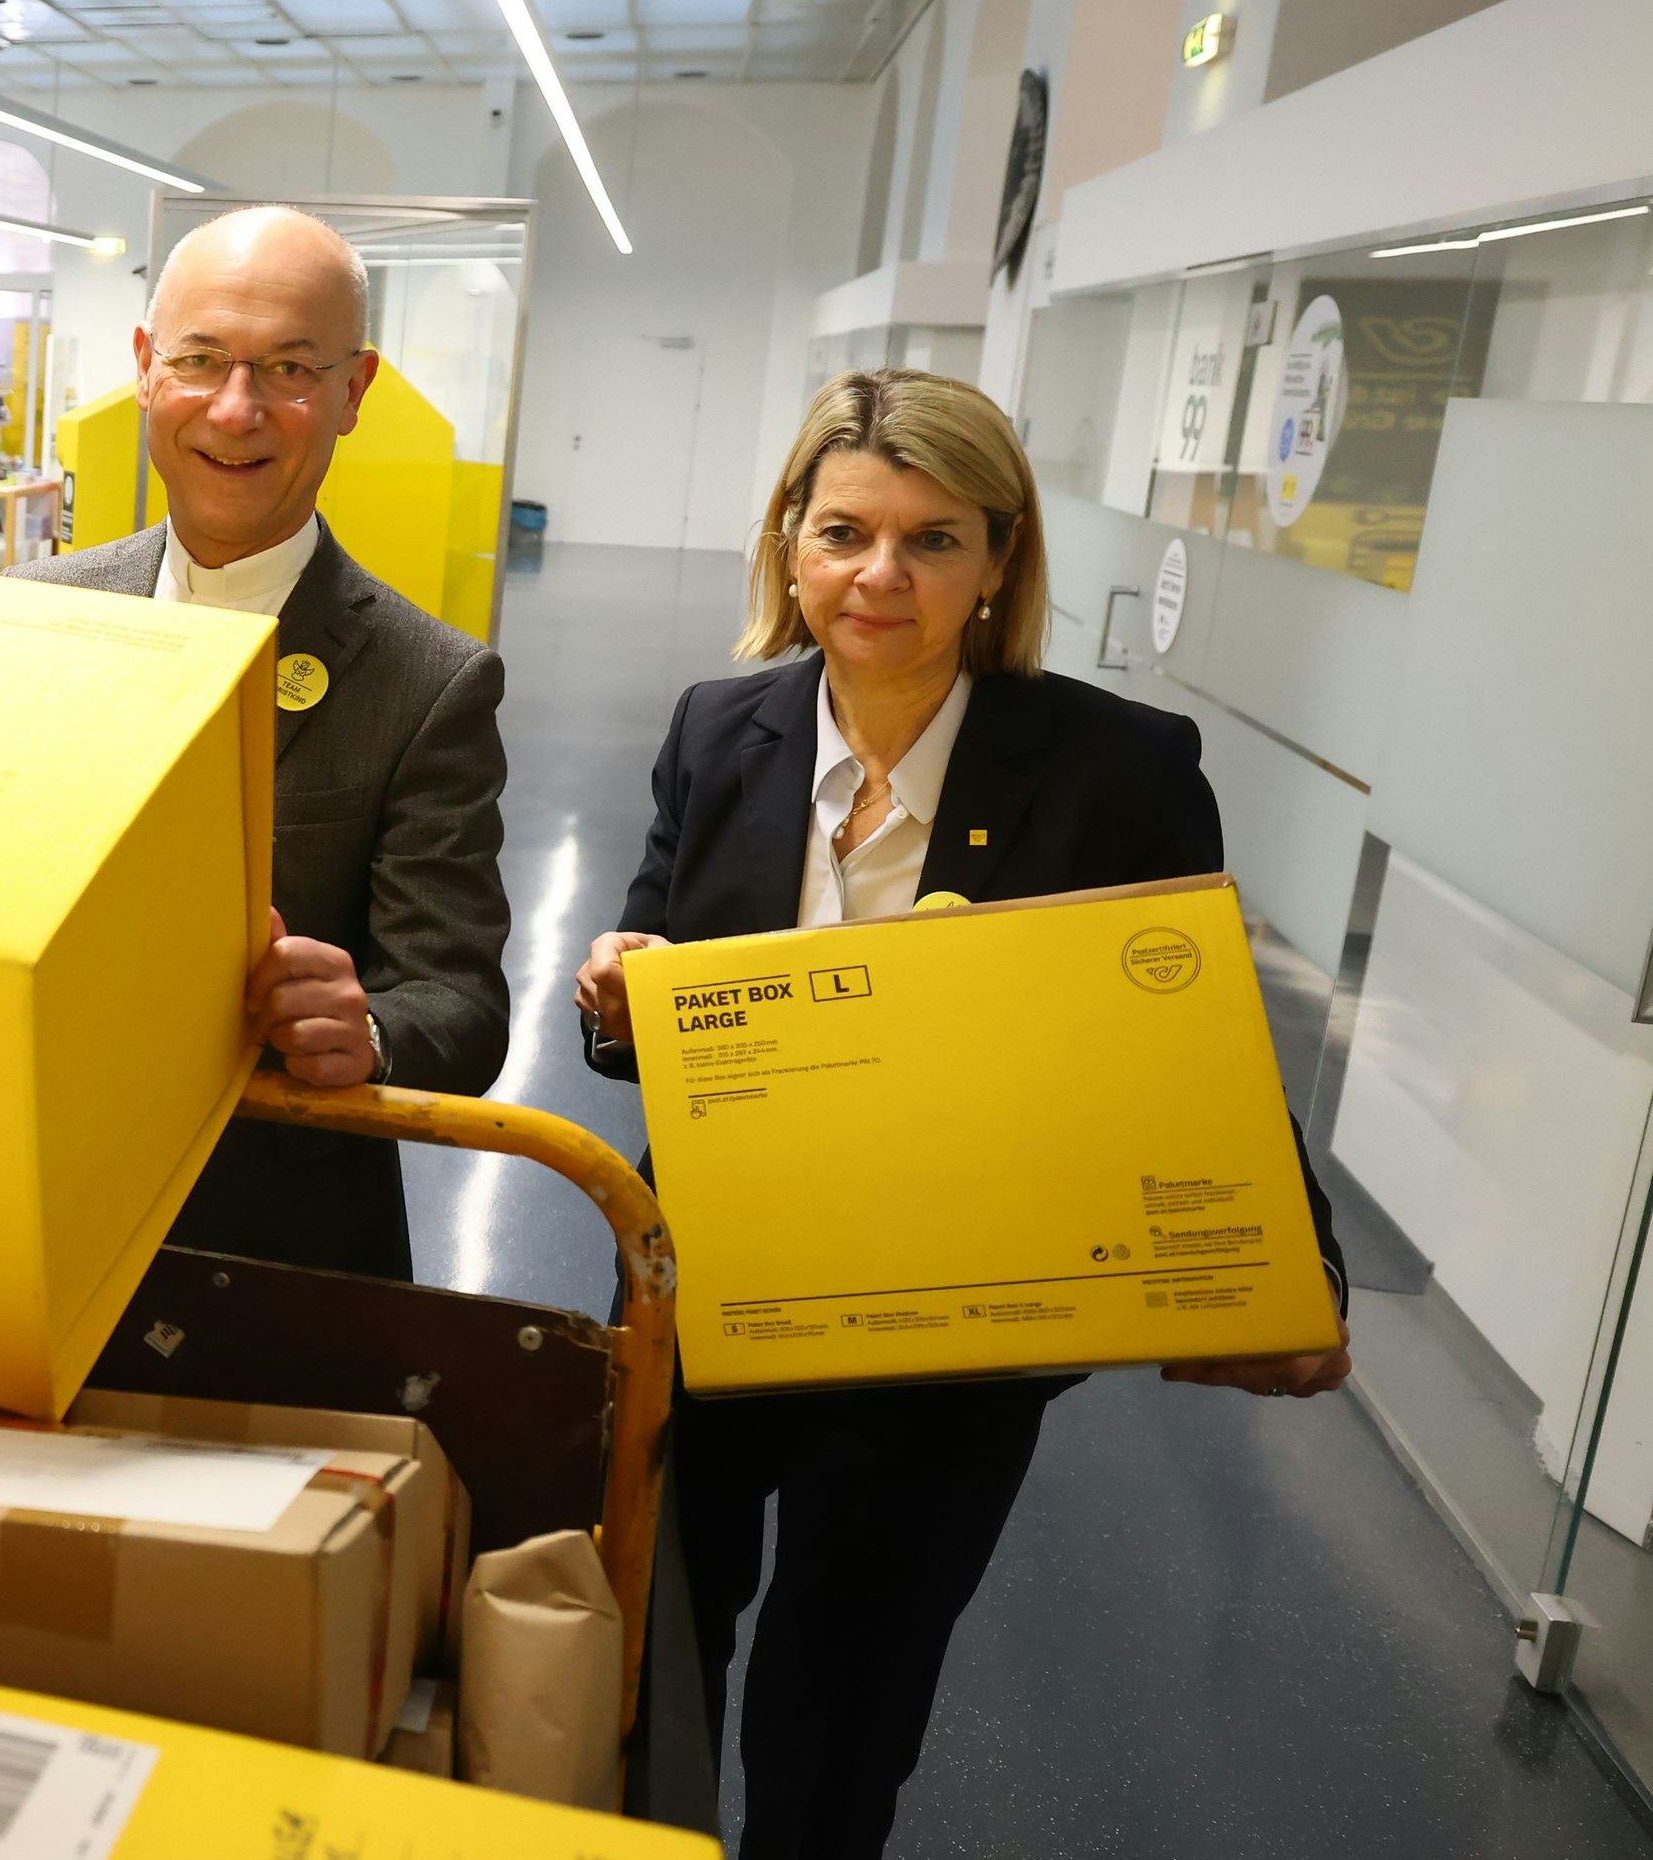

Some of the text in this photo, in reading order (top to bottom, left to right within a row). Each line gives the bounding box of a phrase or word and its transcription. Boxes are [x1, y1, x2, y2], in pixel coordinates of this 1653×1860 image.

[1189, 342, 1227, 387] bank
[1179, 394, 1208, 462] 99
[277, 686, 307, 705] RISTKIND
[282, 680, 301, 695] TEAM
[1161, 952, 1193, 961] Versand
[833, 974, 850, 994] L
[674, 982, 794, 1011] PAKET BOX
[677, 1010, 748, 1033] LARGE
[1158, 1178, 1213, 1189] Paketmarke
[1168, 1225, 1264, 1239] Sendungsverfolgung
[968, 1308, 981, 1316] XL
